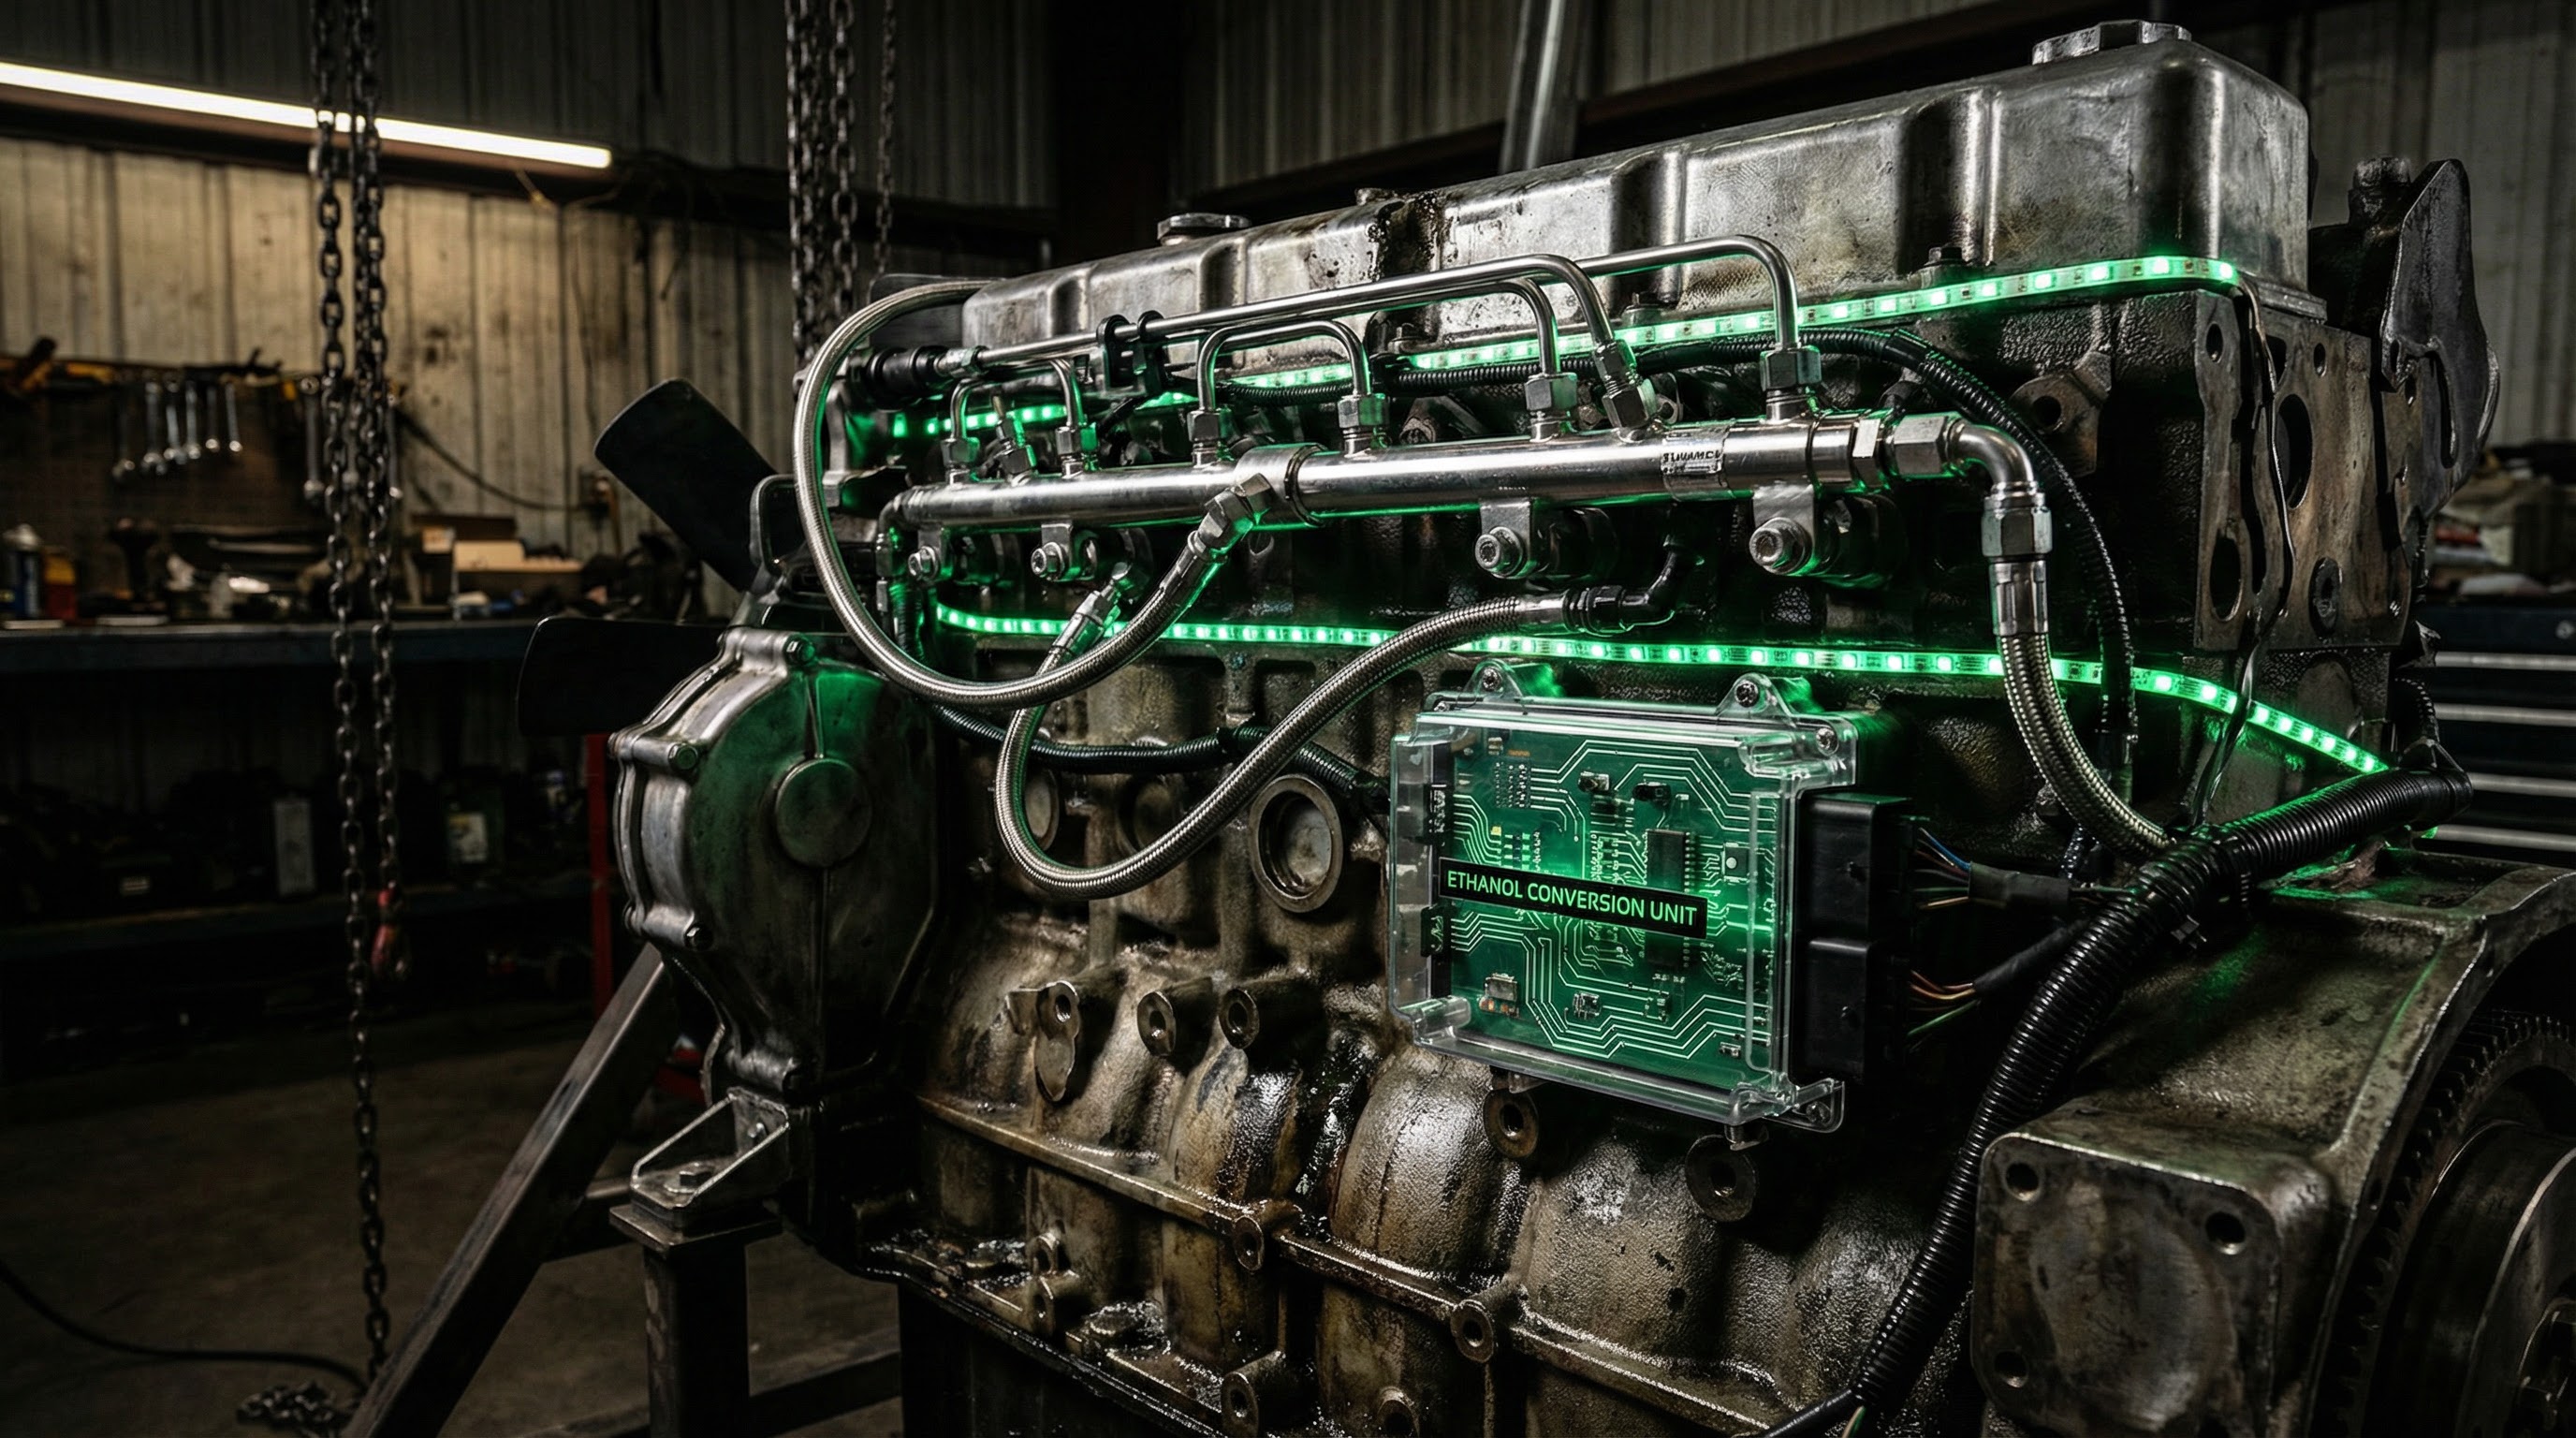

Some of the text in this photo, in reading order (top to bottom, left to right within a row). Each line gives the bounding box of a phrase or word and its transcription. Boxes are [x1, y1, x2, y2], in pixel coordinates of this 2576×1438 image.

[1447, 870, 1699, 926] ETHANOL CONVERSION UNIT
